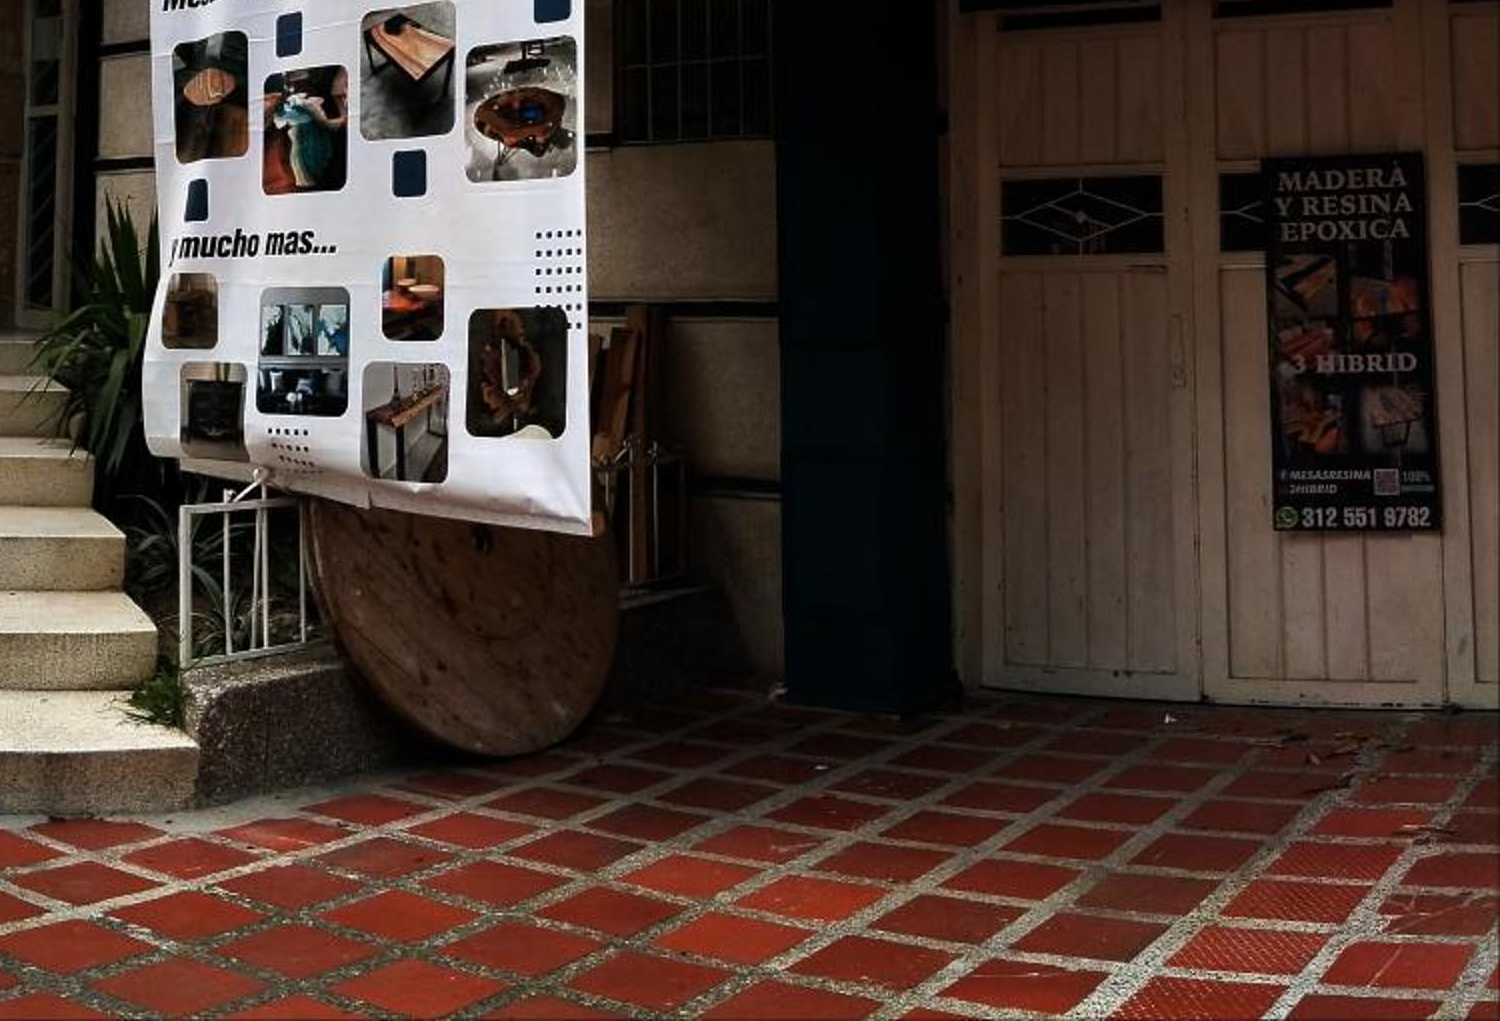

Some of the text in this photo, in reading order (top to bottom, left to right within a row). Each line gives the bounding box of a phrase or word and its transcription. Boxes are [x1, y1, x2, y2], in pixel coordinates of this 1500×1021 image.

[1277, 168, 1408, 192] MADERA
[1273, 192, 1413, 217] Y RESINA
[1281, 218, 1411, 243] EPOXICA
[178, 229, 259, 259] mucho
[265, 230, 337, 256] mas...
[1293, 353, 1417, 374] 3 HIBRID
[1302, 506, 1432, 528] 312 551 9782
